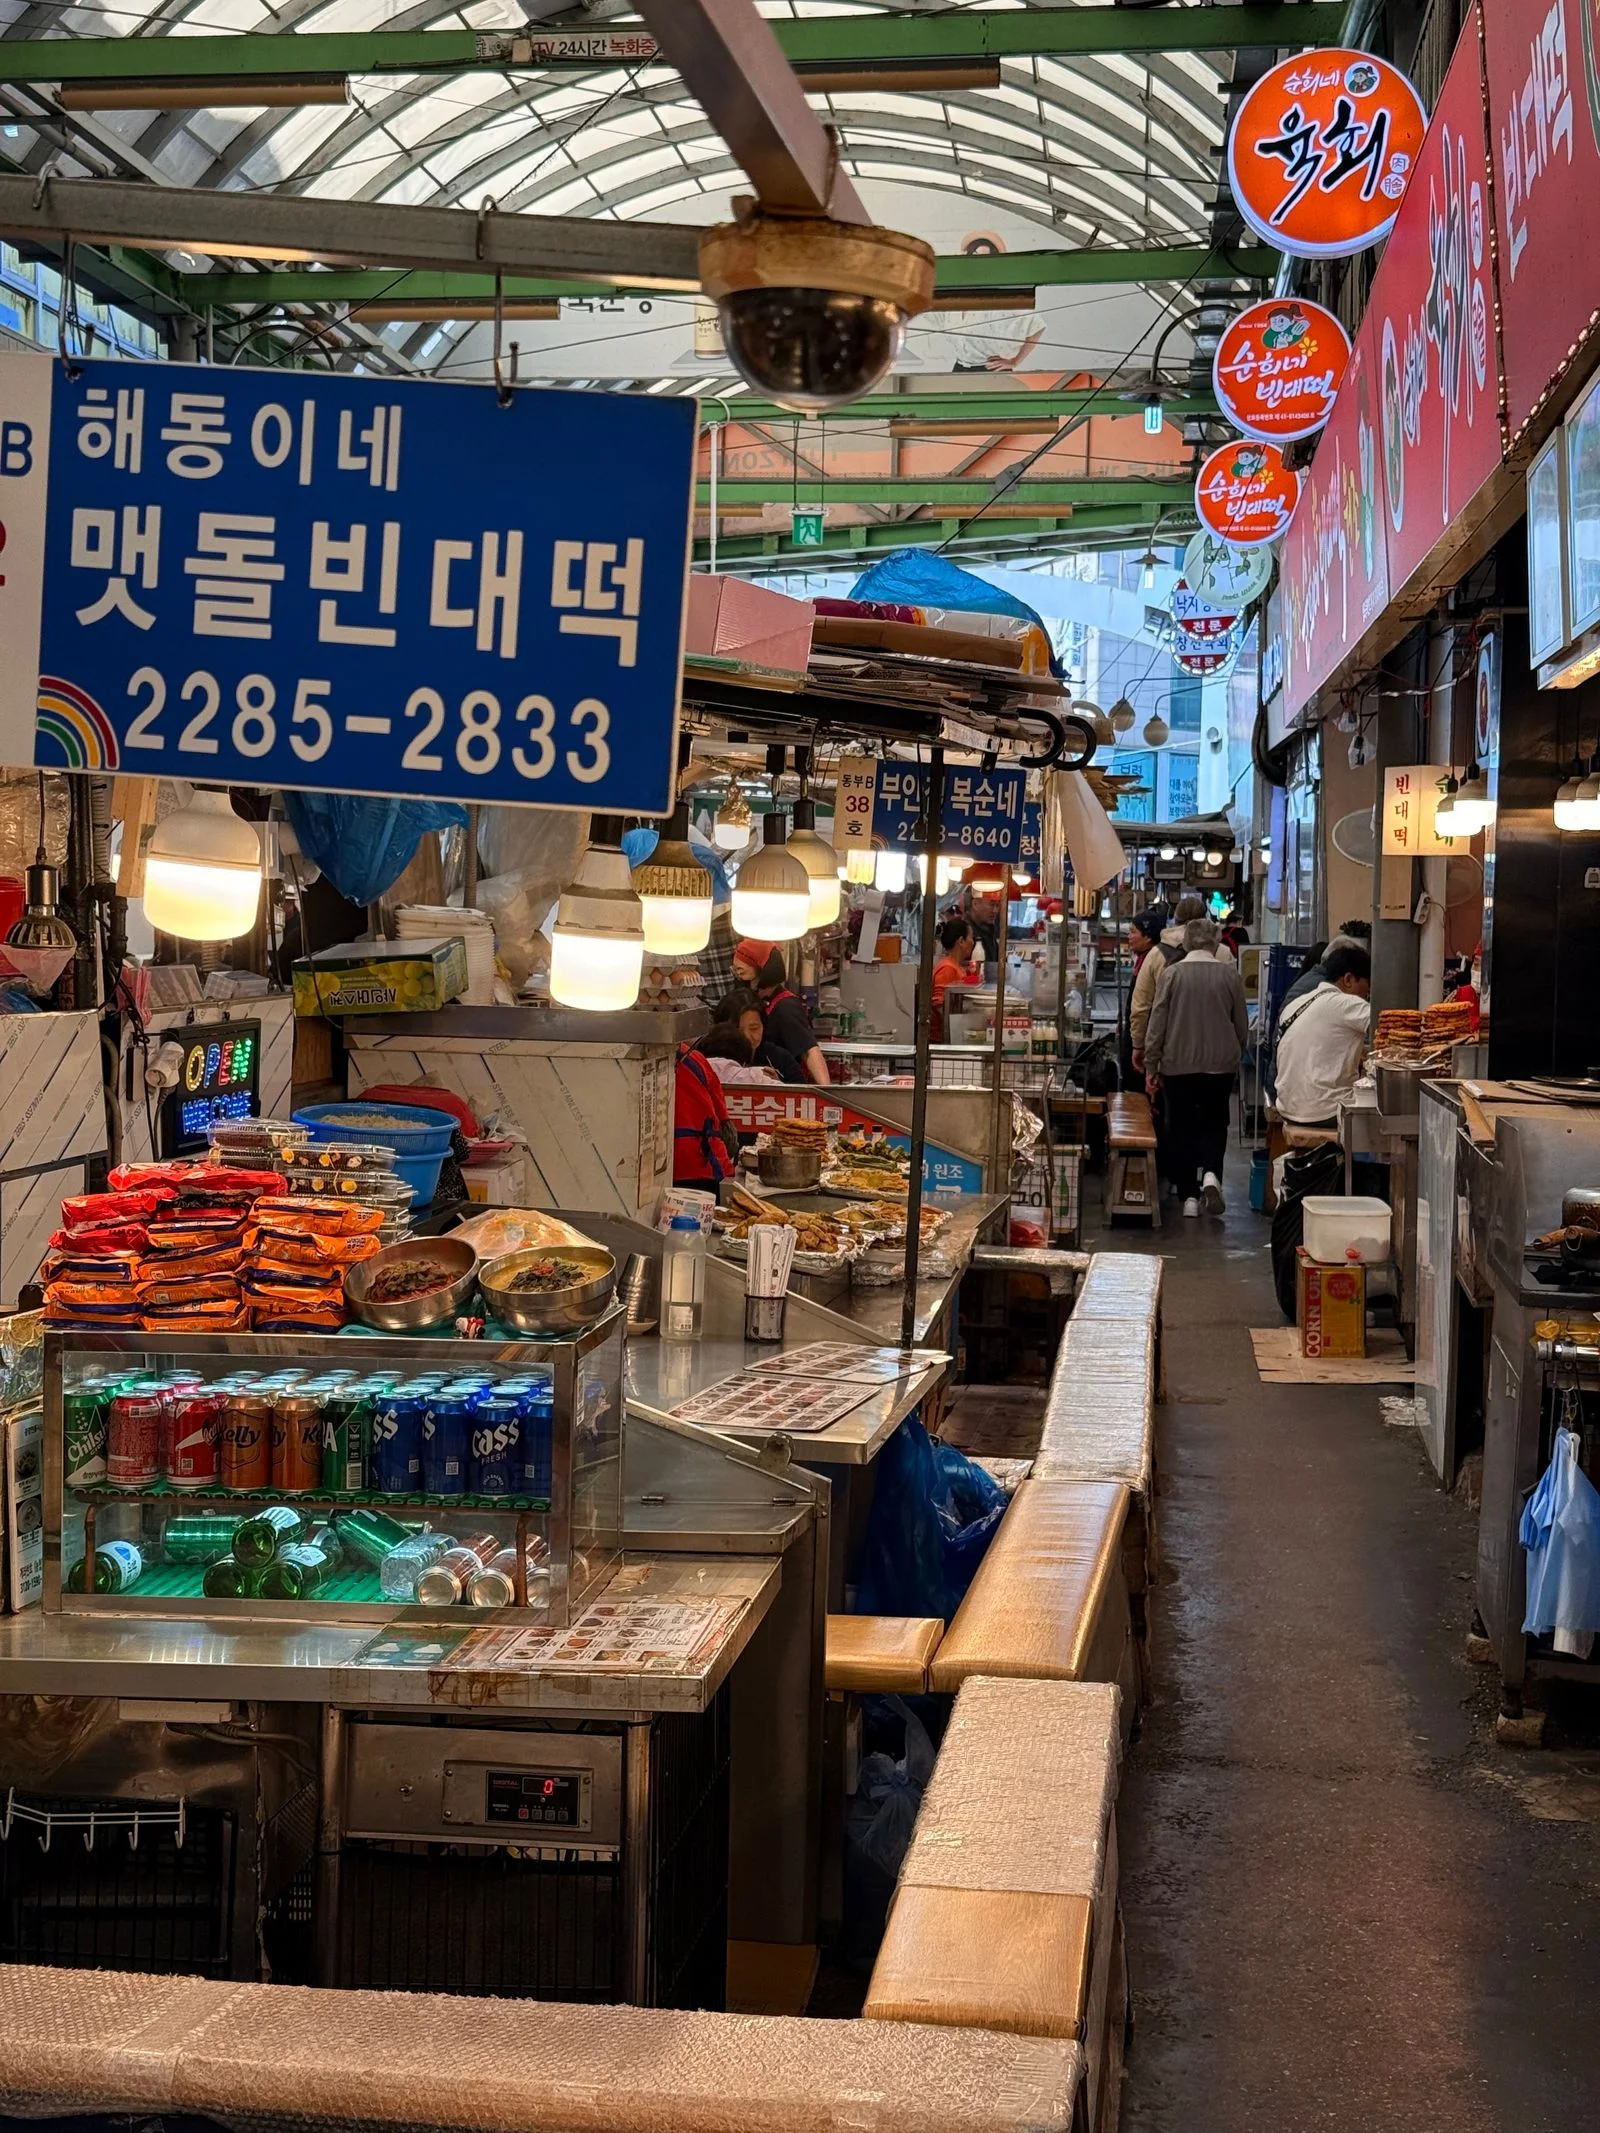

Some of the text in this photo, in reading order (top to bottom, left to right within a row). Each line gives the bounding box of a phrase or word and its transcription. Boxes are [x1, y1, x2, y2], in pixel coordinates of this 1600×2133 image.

[558, 39, 607, 57] 24시간
[609, 38, 657, 57] 녹화중
[1283, 66, 1340, 96] 순희네
[1255, 97, 1392, 224] 육회
[1502, 0, 1574, 284] 빈대떡
[1427, 123, 1473, 526] 육회
[1219, 341, 1308, 383] 순희네
[1256, 369, 1337, 416] 빈대떡
[77, 389, 401, 491] 해동이네
[1199, 471, 1266, 503] 순희네
[1225, 494, 1289, 529] 빈대떡
[70, 505, 644, 668] 맷돌빈대떡
[125, 668, 610, 783] 2285-2833
[841, 774, 874, 789] 동부B
[951, 777, 1018, 819] 복순네
[845, 796, 870, 813] 38
[1393, 774, 1411, 847] 빈대떡
[845, 821, 863, 837] 호
[186, 1037, 252, 1091] OPEN
[724, 1095, 816, 1126] 복순네
[933, 1163, 964, 1180] 원조
[1306, 1305, 1320, 1357] CORN
[481, 1452, 507, 1464] FRESH
[543, 1779, 554, 1794] 0
